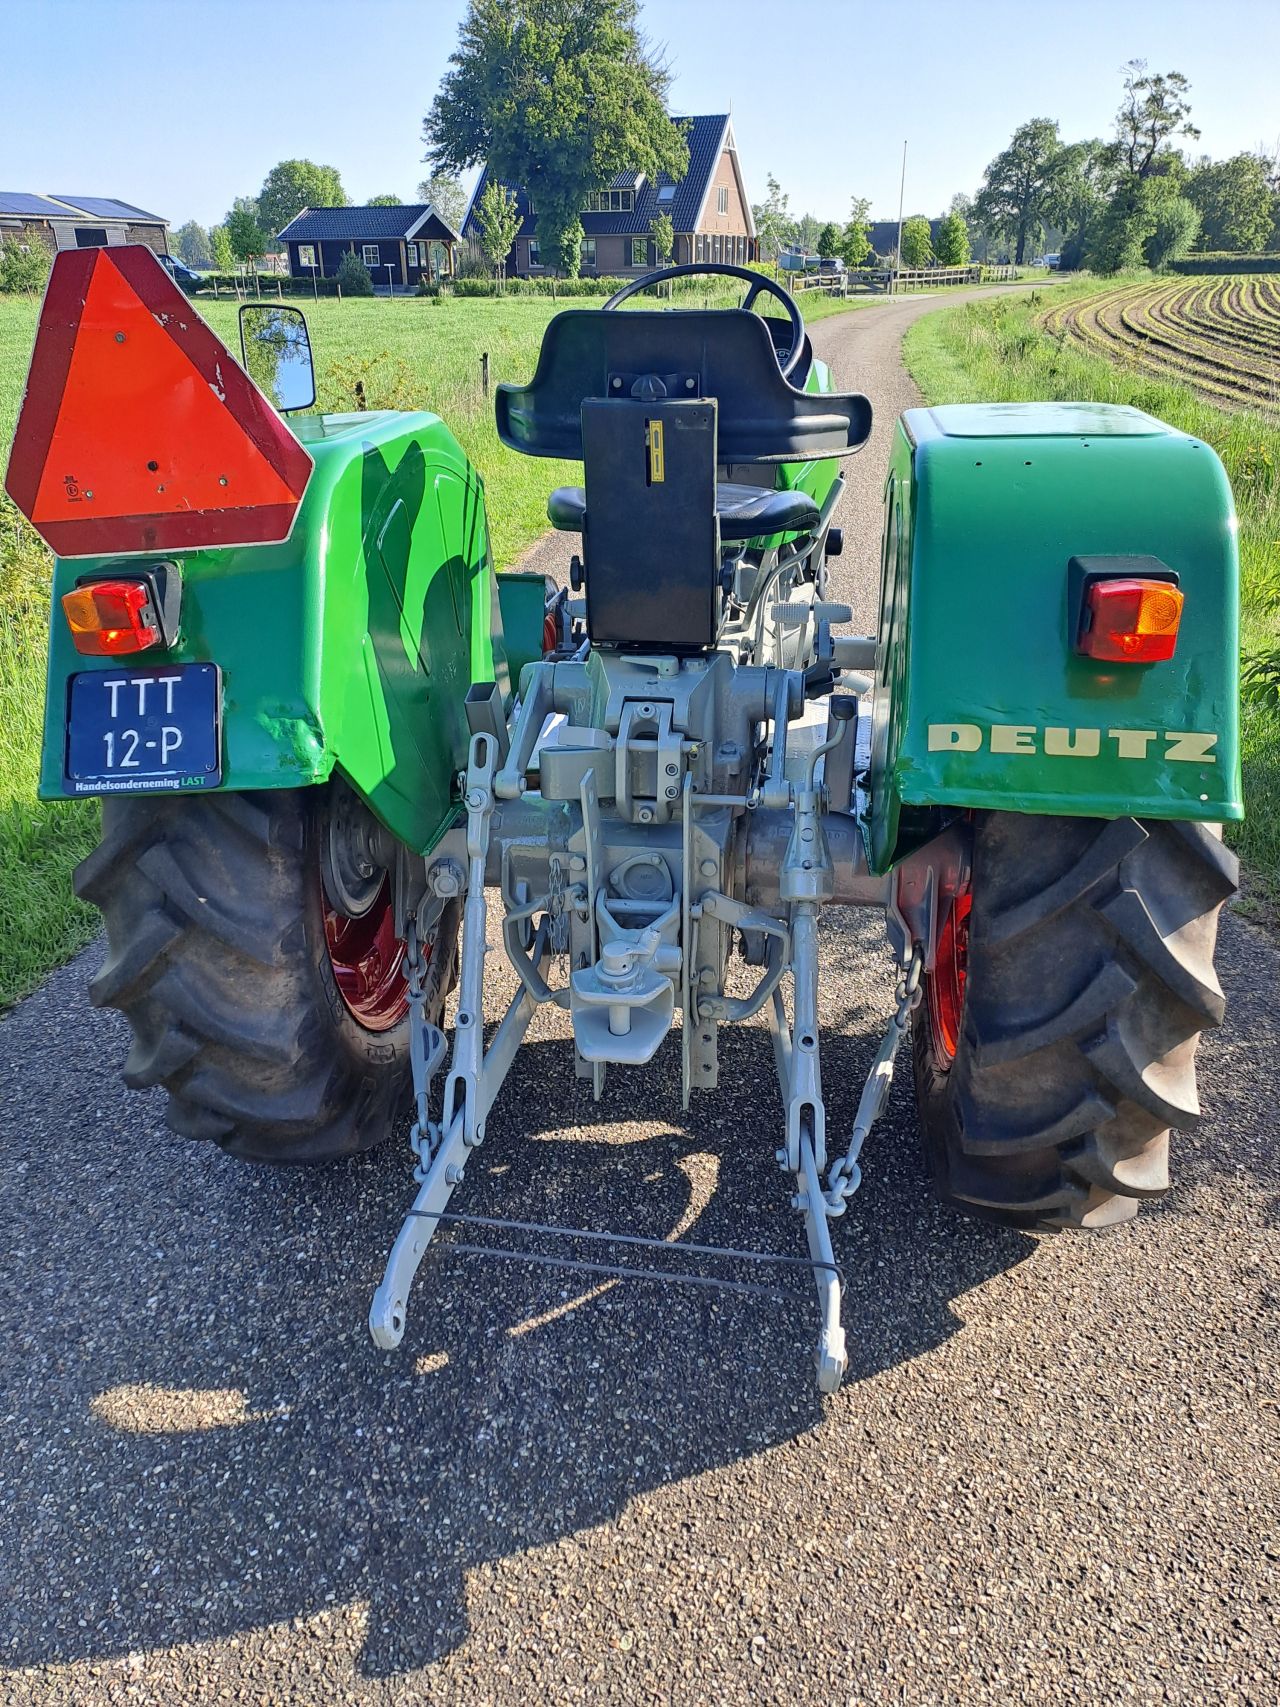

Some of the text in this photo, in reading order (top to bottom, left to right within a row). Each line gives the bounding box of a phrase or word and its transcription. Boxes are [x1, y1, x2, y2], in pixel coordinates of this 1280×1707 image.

[103, 676, 182, 718] TTT
[103, 727, 183, 768] 12-P
[928, 724, 1218, 763] DEUTZ
[75, 776, 206, 792] Handelsonderneming LAST
